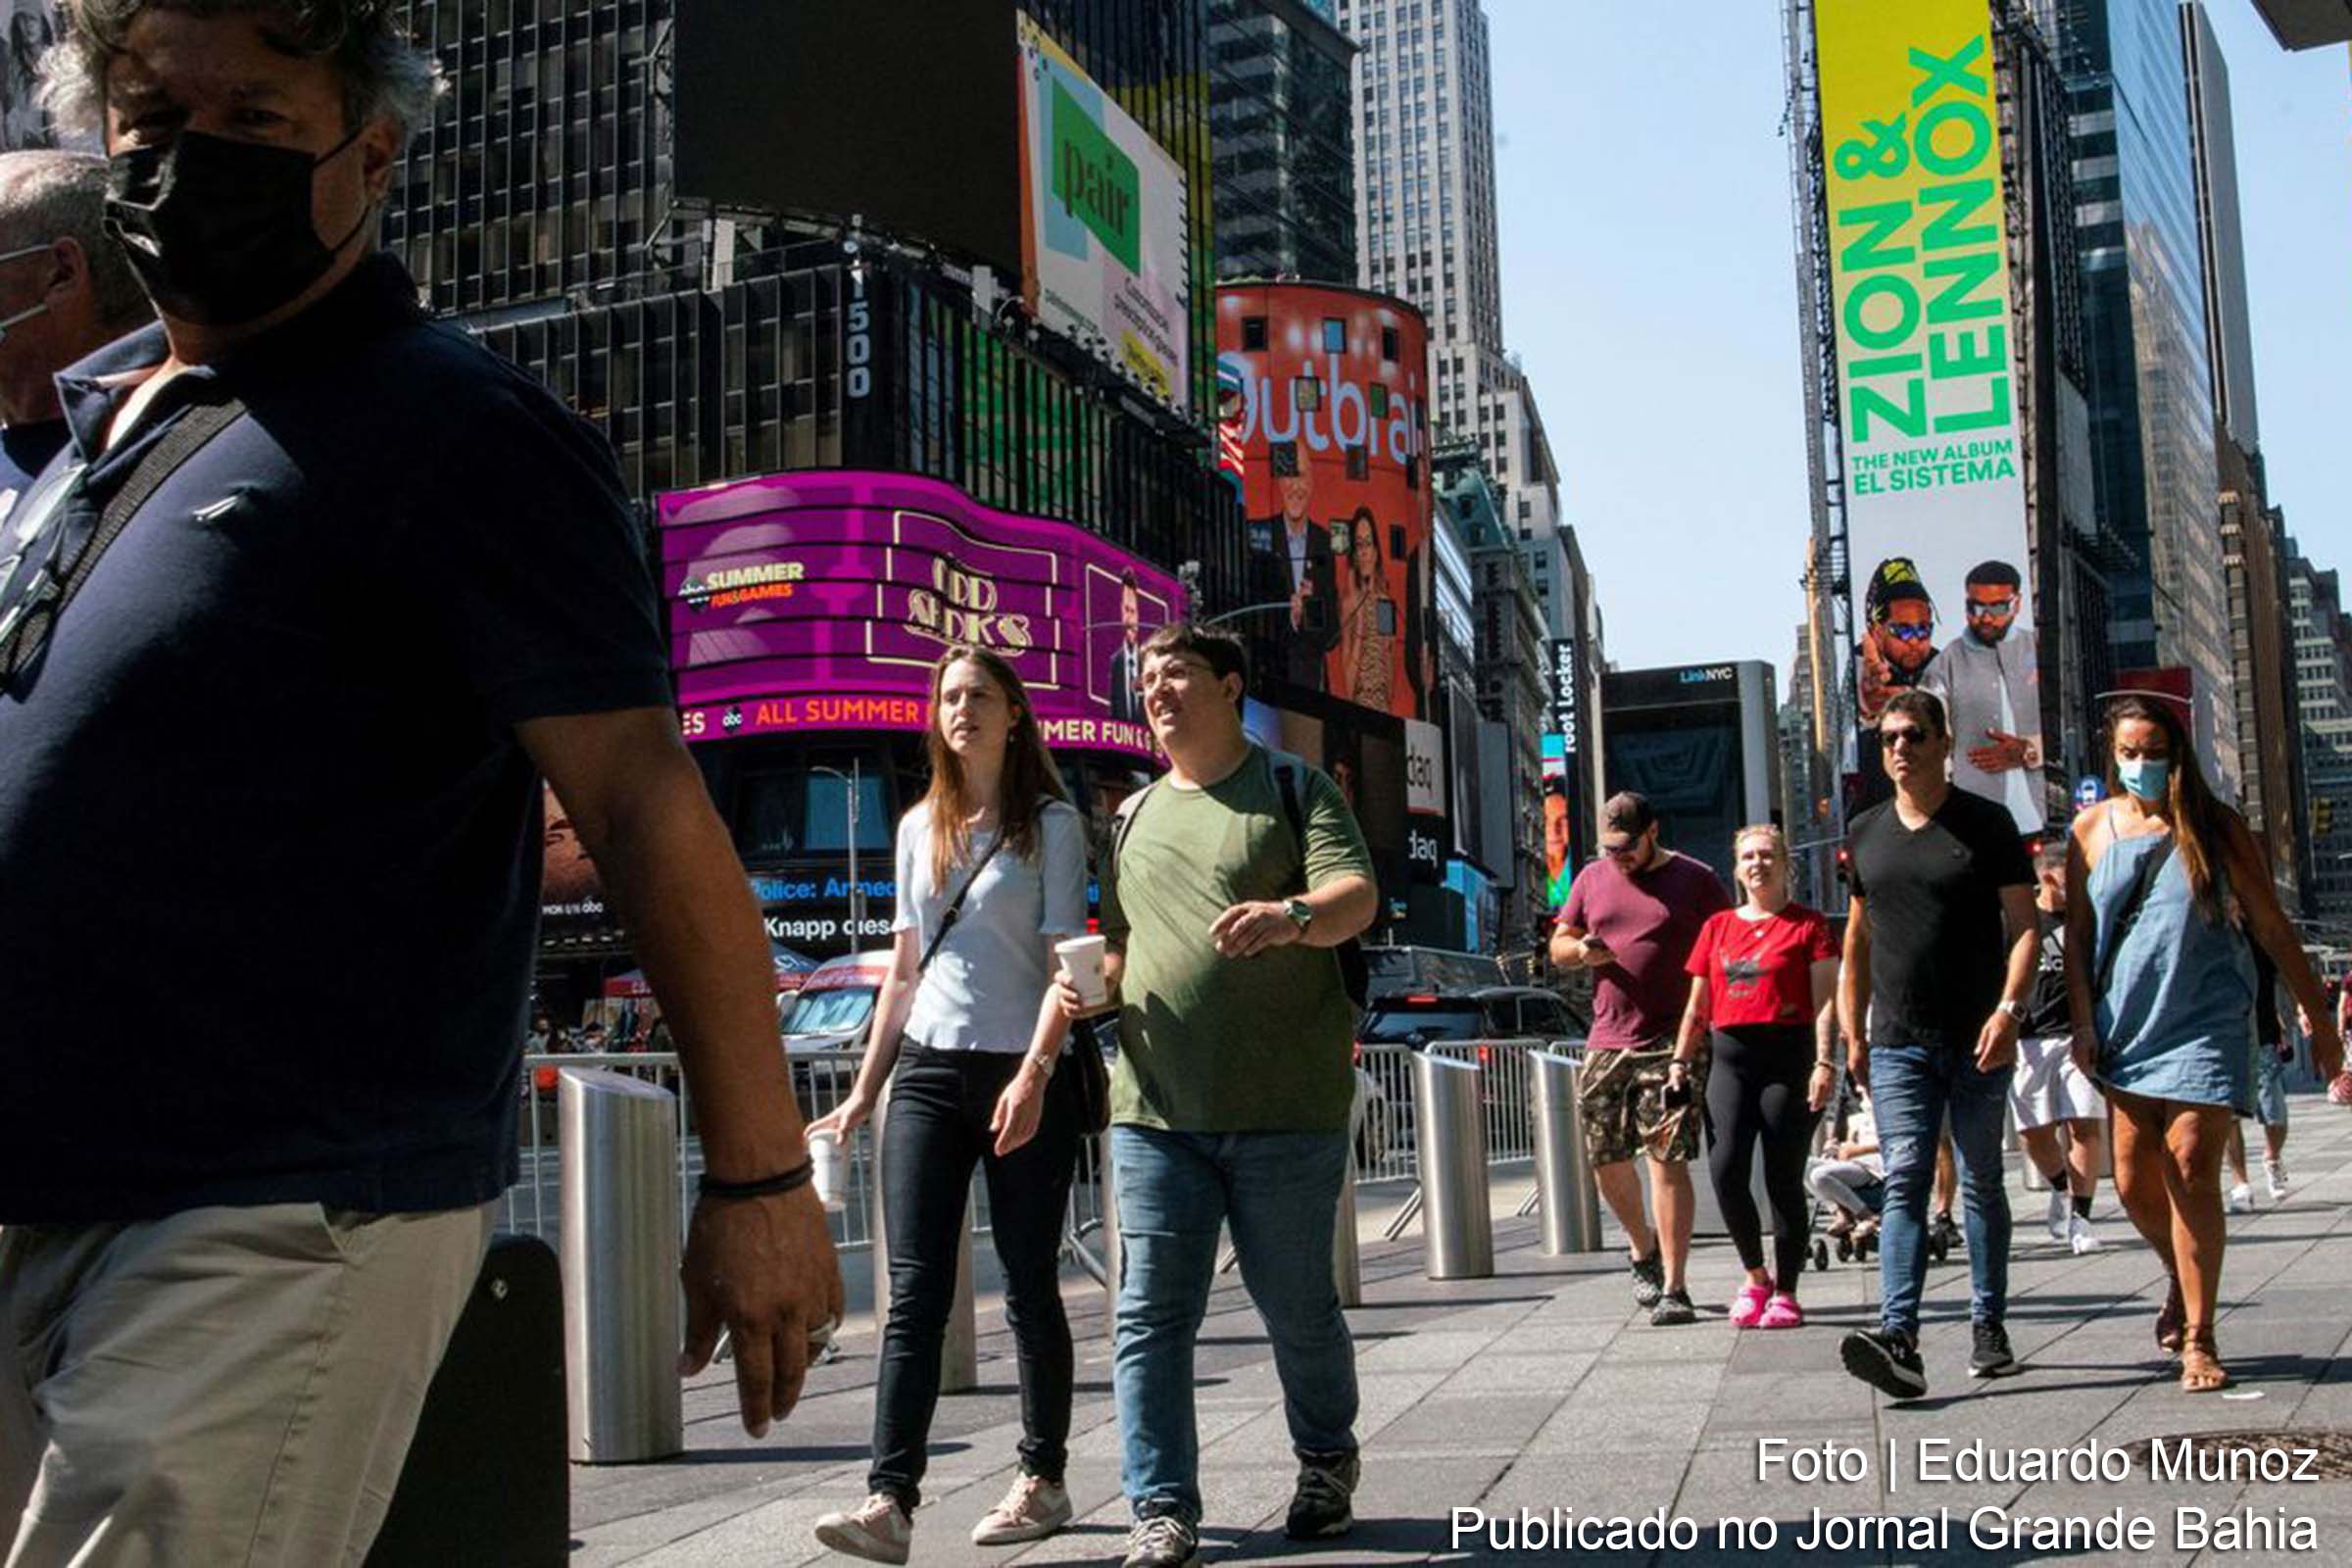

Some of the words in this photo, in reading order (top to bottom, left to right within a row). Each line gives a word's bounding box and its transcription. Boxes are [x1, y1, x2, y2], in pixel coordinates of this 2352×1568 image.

[1834, 112, 1911, 180] &
[1064, 139, 1130, 236] pair
[1908, 34, 2011, 433] LENNOX
[846, 266, 870, 398] 1500
[1838, 200, 1928, 443] ZION
[1217, 351, 1426, 466] Outbrai
[1852, 454, 1887, 470] THE
[1893, 447, 1938, 466] NEW
[1943, 439, 2013, 460] ALBUM
[1854, 472, 1886, 495] EL
[1889, 458, 2016, 491] SISTEMA
[707, 562, 805, 590] SUMMER
[1556, 643, 1575, 708] Locker
[1680, 666, 1734, 683] LinkNYC
[756, 702, 798, 725] ALL
[806, 699, 918, 723] SUMMER
[1038, 719, 1096, 743] MER
[1102, 721, 1133, 746] FUN
[763, 917, 837, 942] Knapp
